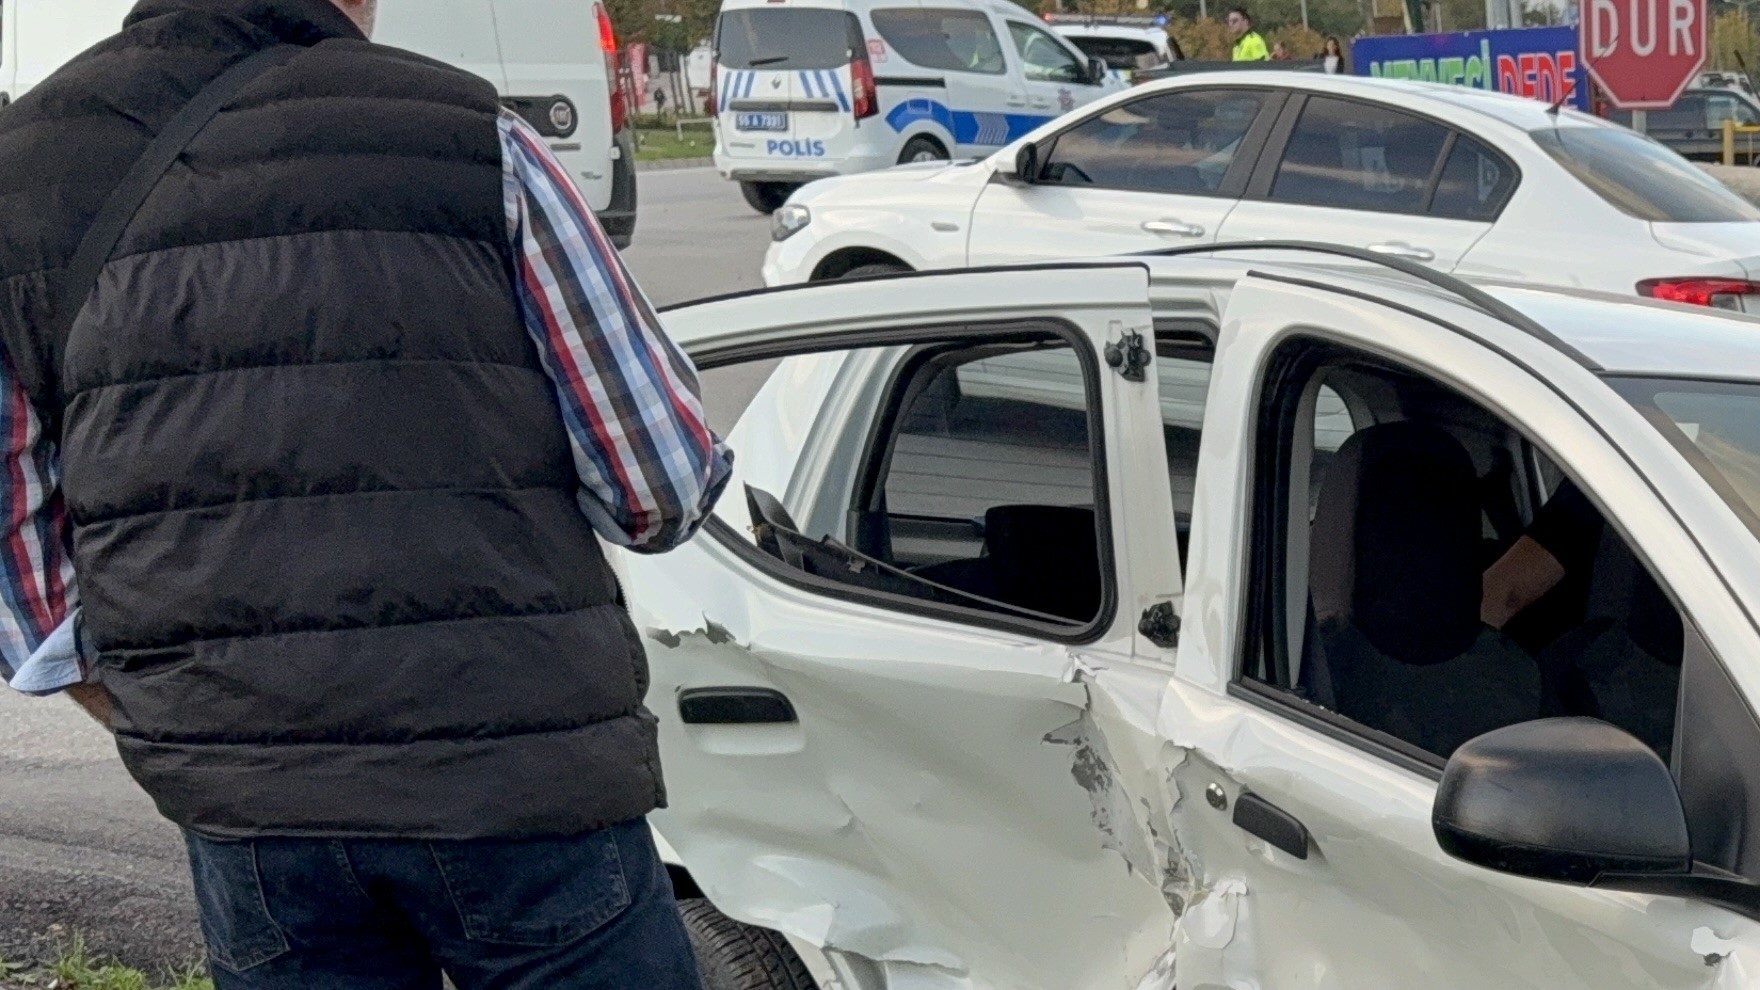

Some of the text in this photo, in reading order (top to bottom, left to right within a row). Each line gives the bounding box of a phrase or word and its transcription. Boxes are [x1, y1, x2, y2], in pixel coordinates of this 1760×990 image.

[1592, 0, 1695, 58] DUR
[1497, 51, 1577, 109] DEDE
[766, 137, 825, 157] POLİS
